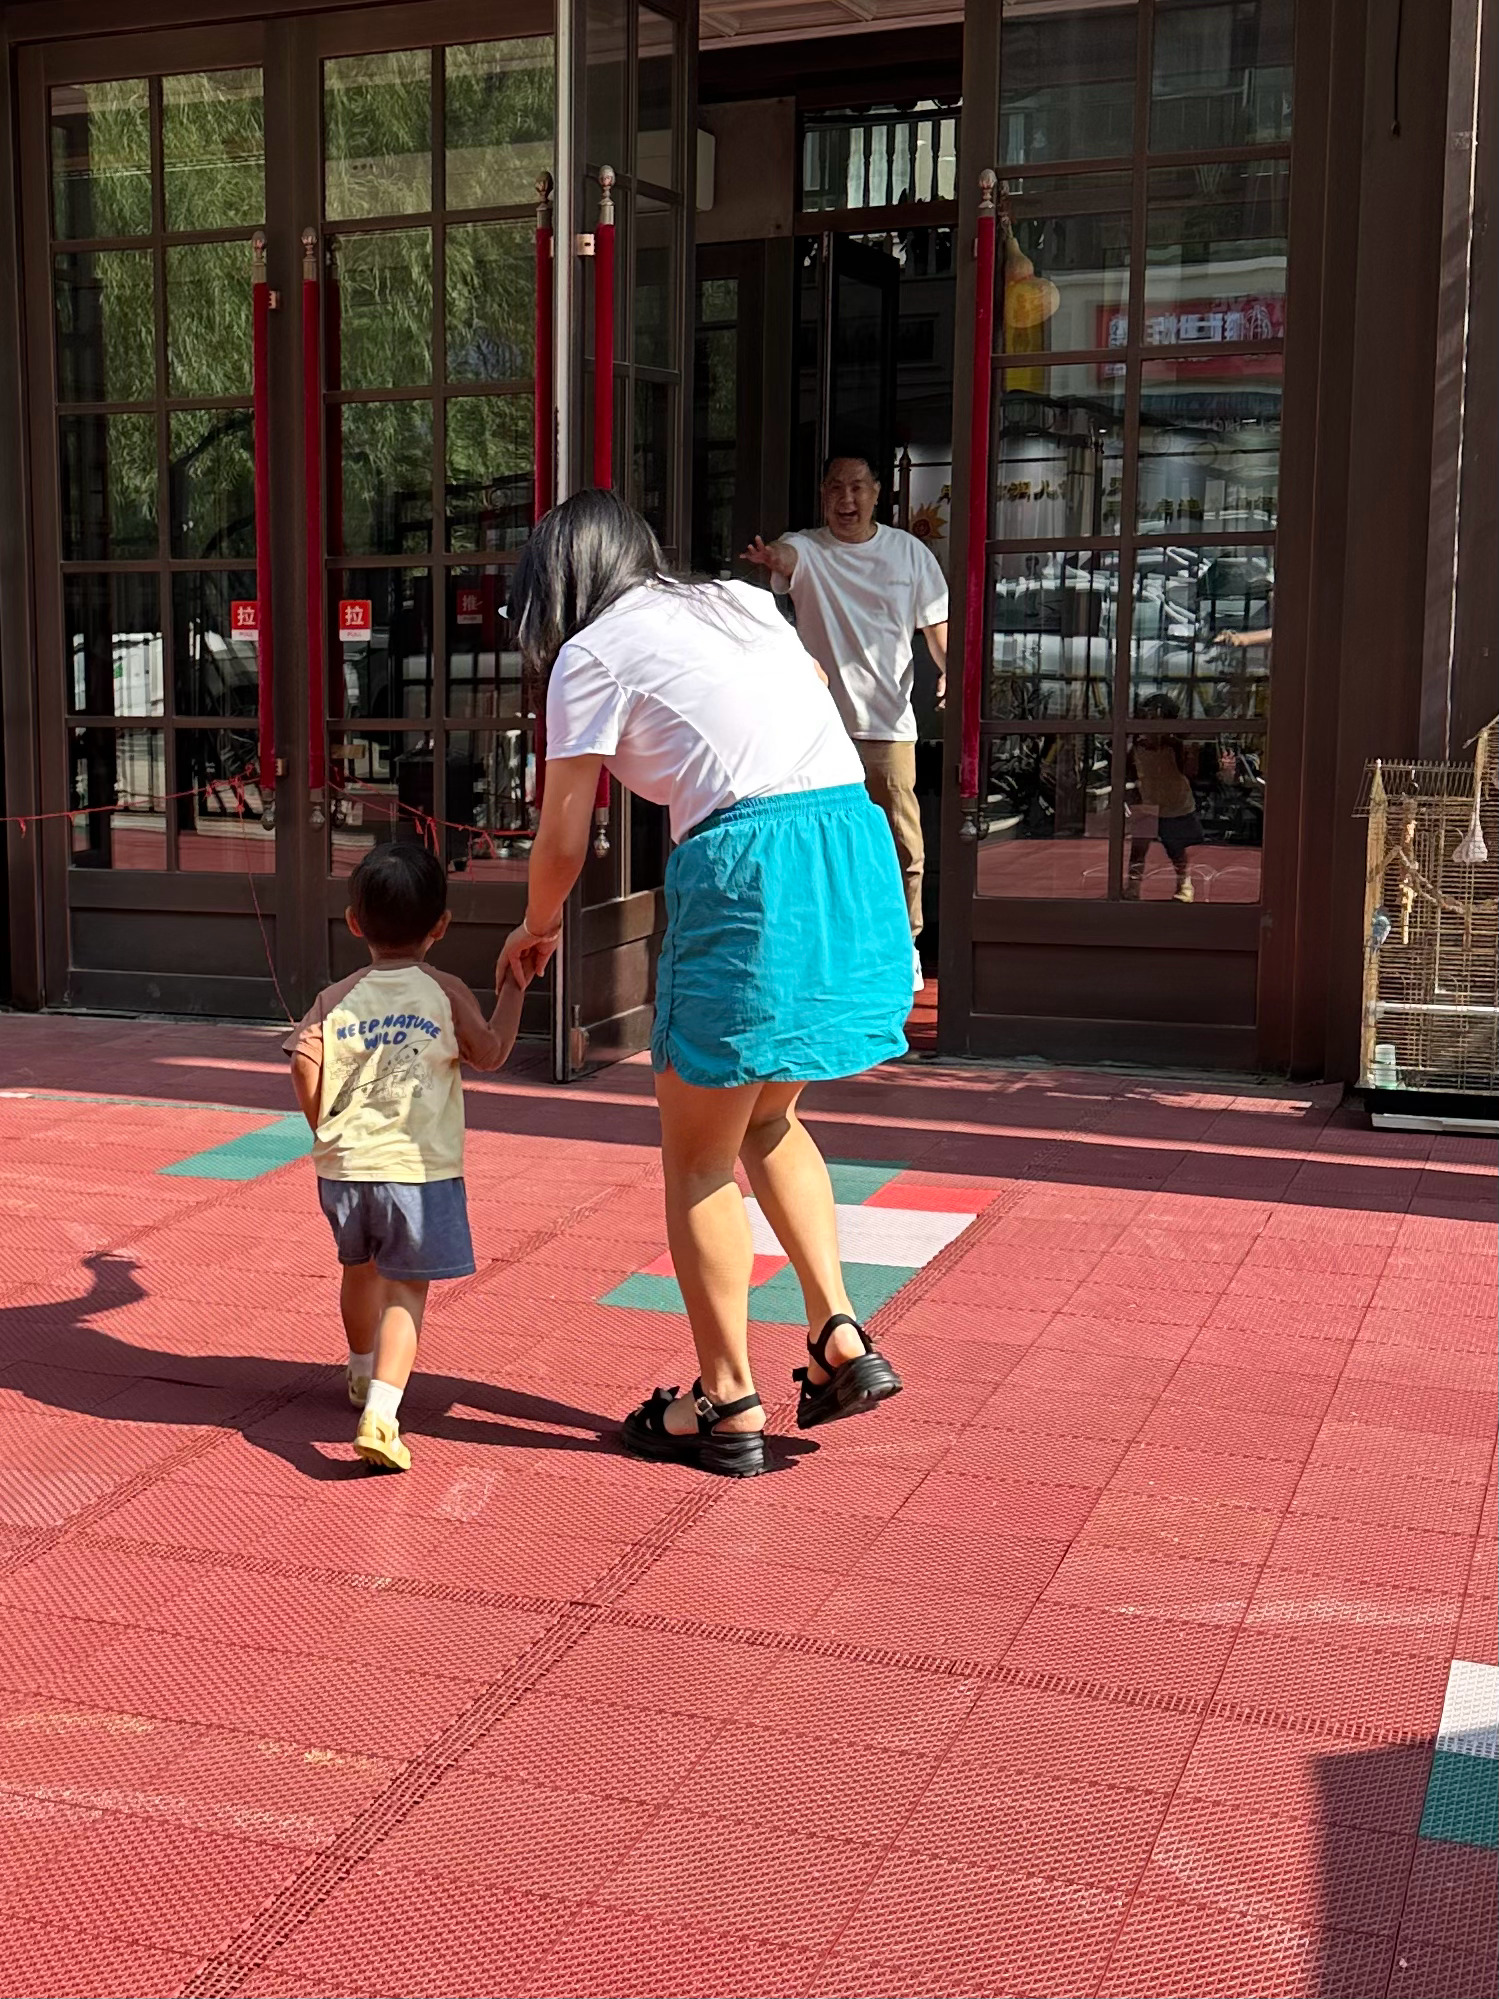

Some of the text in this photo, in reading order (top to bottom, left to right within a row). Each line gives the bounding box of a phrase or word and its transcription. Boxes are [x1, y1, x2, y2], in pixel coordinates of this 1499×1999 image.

[462, 594, 479, 612] 推
[237, 605, 256, 626] 拉
[345, 605, 364, 626] 拉
[336, 1014, 442, 1041] KEEP NATURE
[364, 1030, 408, 1050] WILD
